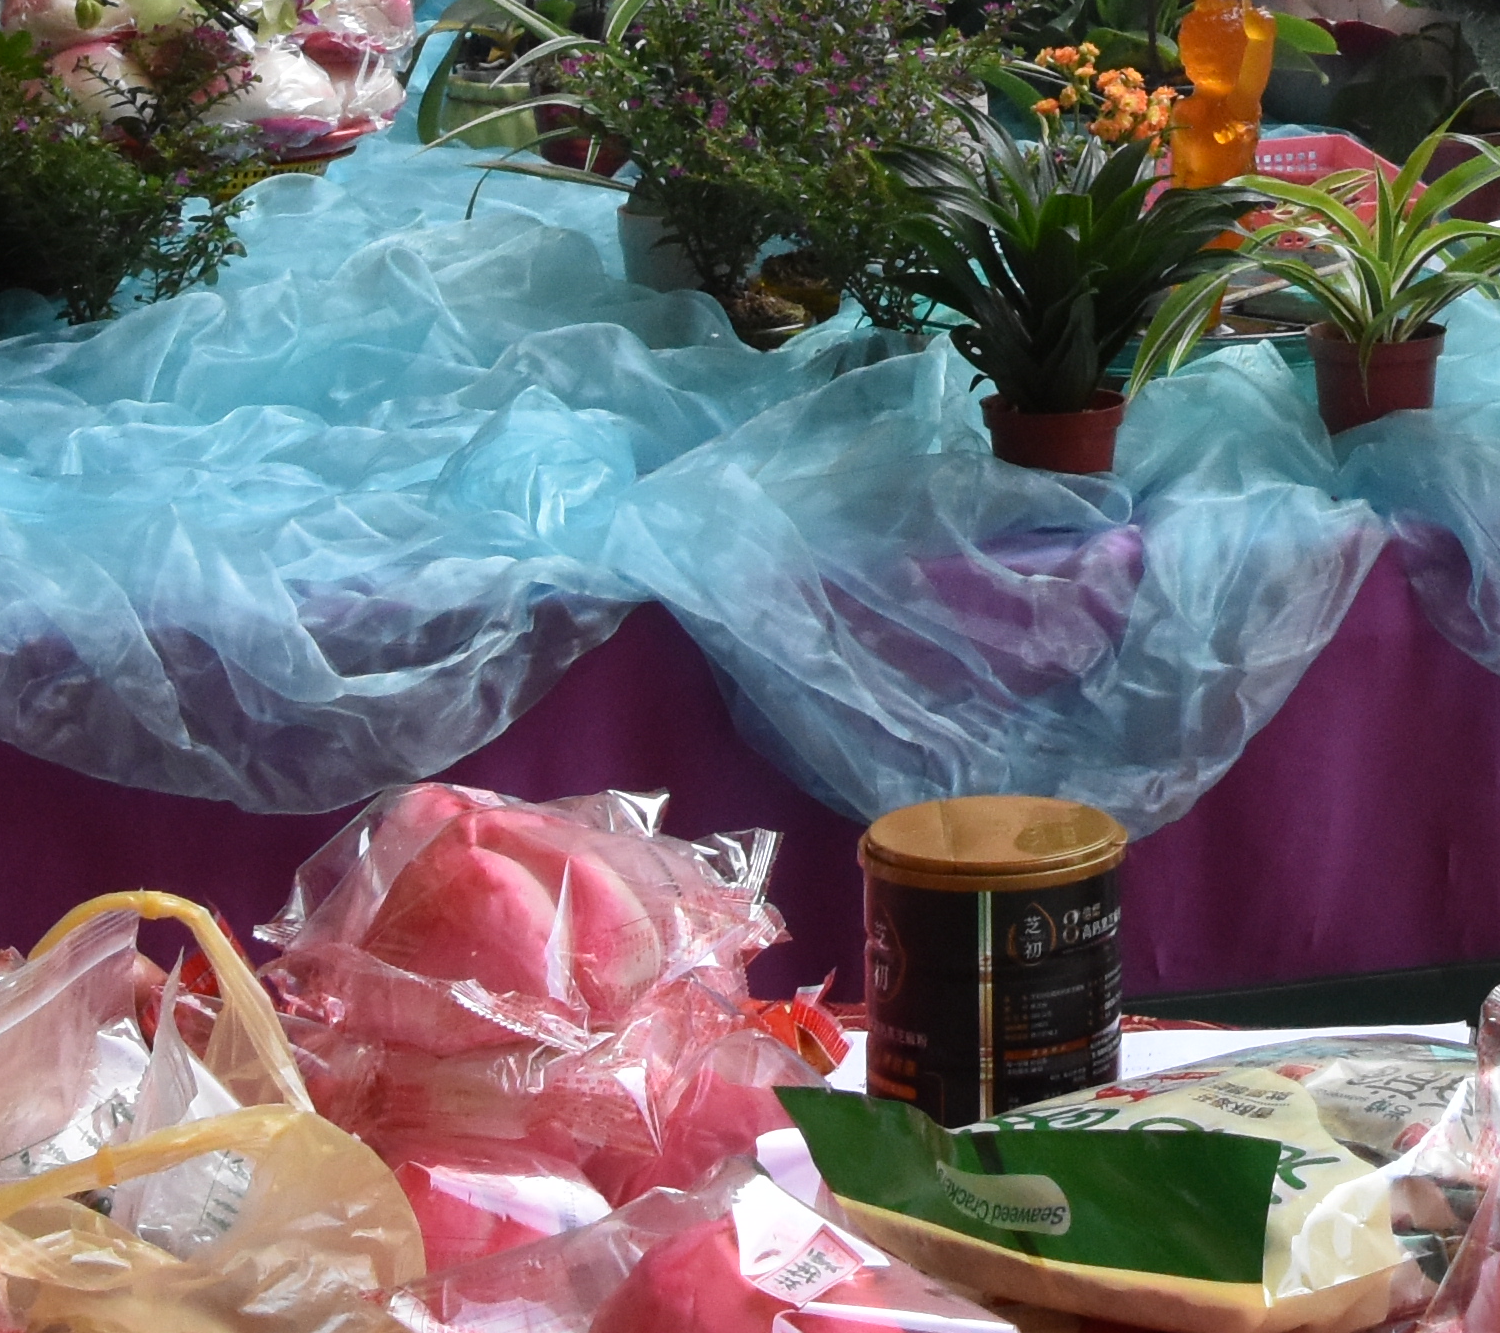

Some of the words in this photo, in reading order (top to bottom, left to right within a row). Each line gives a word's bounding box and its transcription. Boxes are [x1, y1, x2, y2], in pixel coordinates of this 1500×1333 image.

[1023, 916, 1043, 960] 芝初
[1062, 908, 1080, 945] 8
[991, 1206, 1067, 1226] Seaweed
